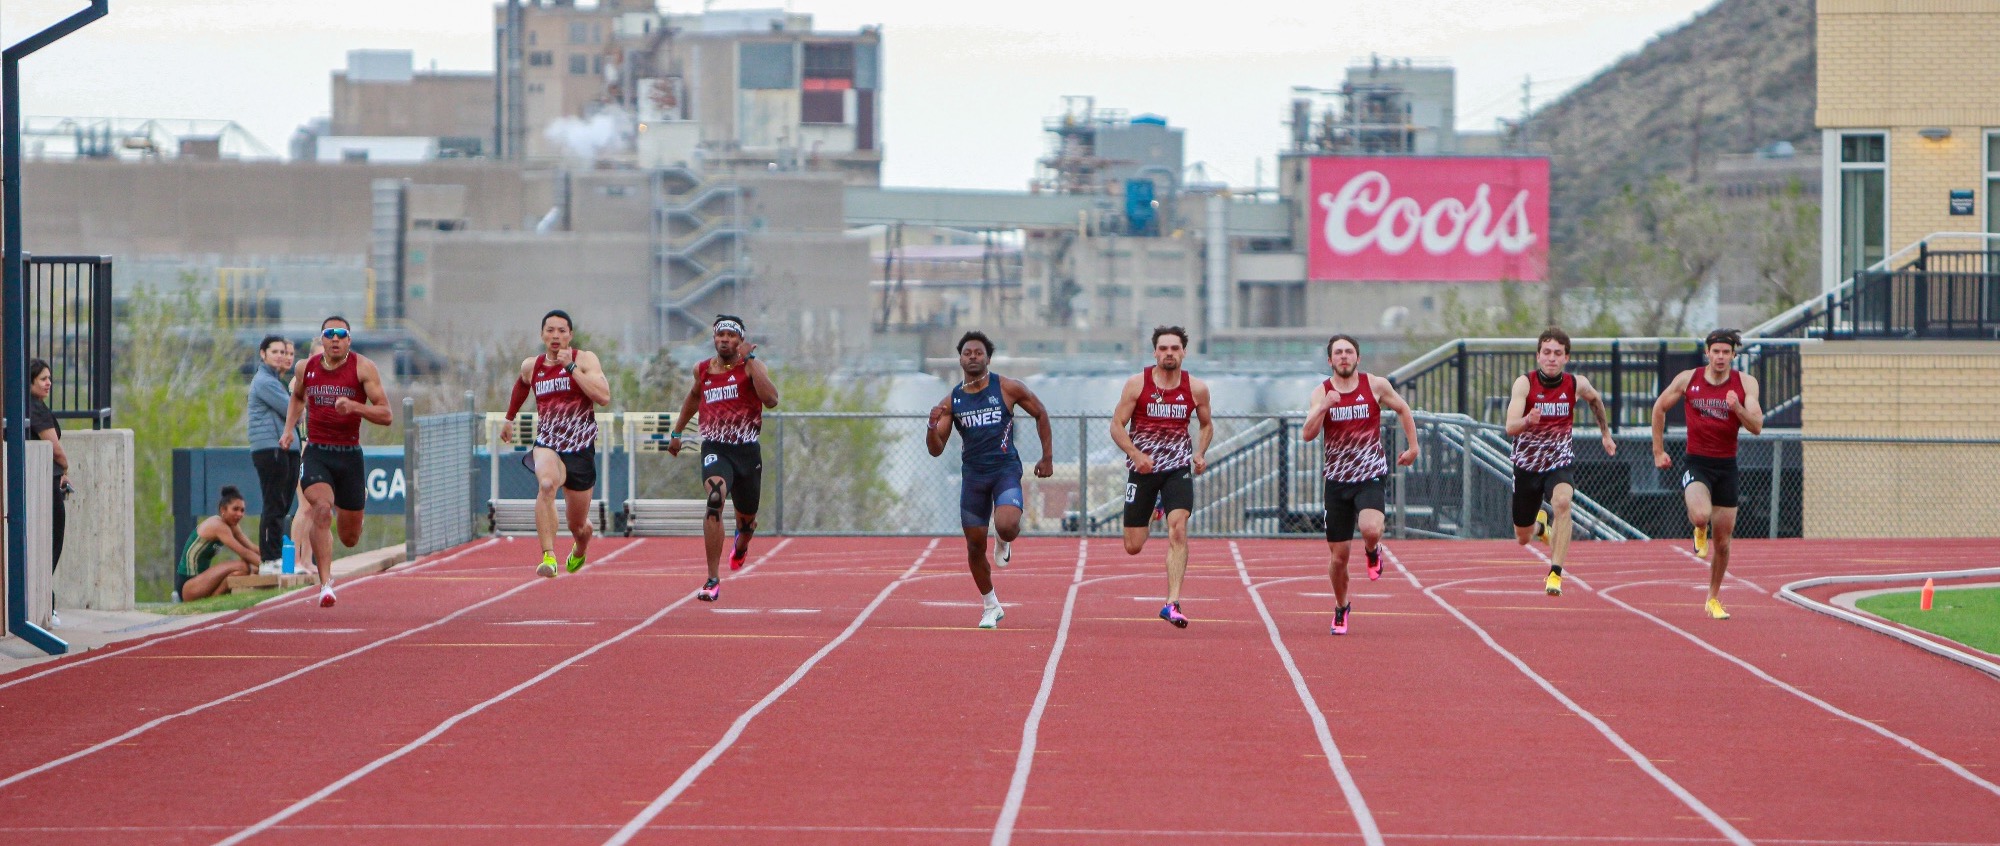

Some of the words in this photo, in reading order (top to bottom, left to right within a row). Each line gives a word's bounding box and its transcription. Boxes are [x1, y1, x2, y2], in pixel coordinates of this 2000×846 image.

[1318, 170, 1538, 256] Coors
[555, 376, 571, 391] STATE
[723, 384, 739, 400] STATE
[1146, 403, 1171, 418] CHADRON
[1171, 404, 1188, 418] STATE
[1330, 406, 1353, 421] CHADRON
[1353, 404, 1370, 419] STATE
[1556, 403, 1570, 416] STATE
[957, 411, 1002, 428] MINES
[365, 468, 407, 500] GA
